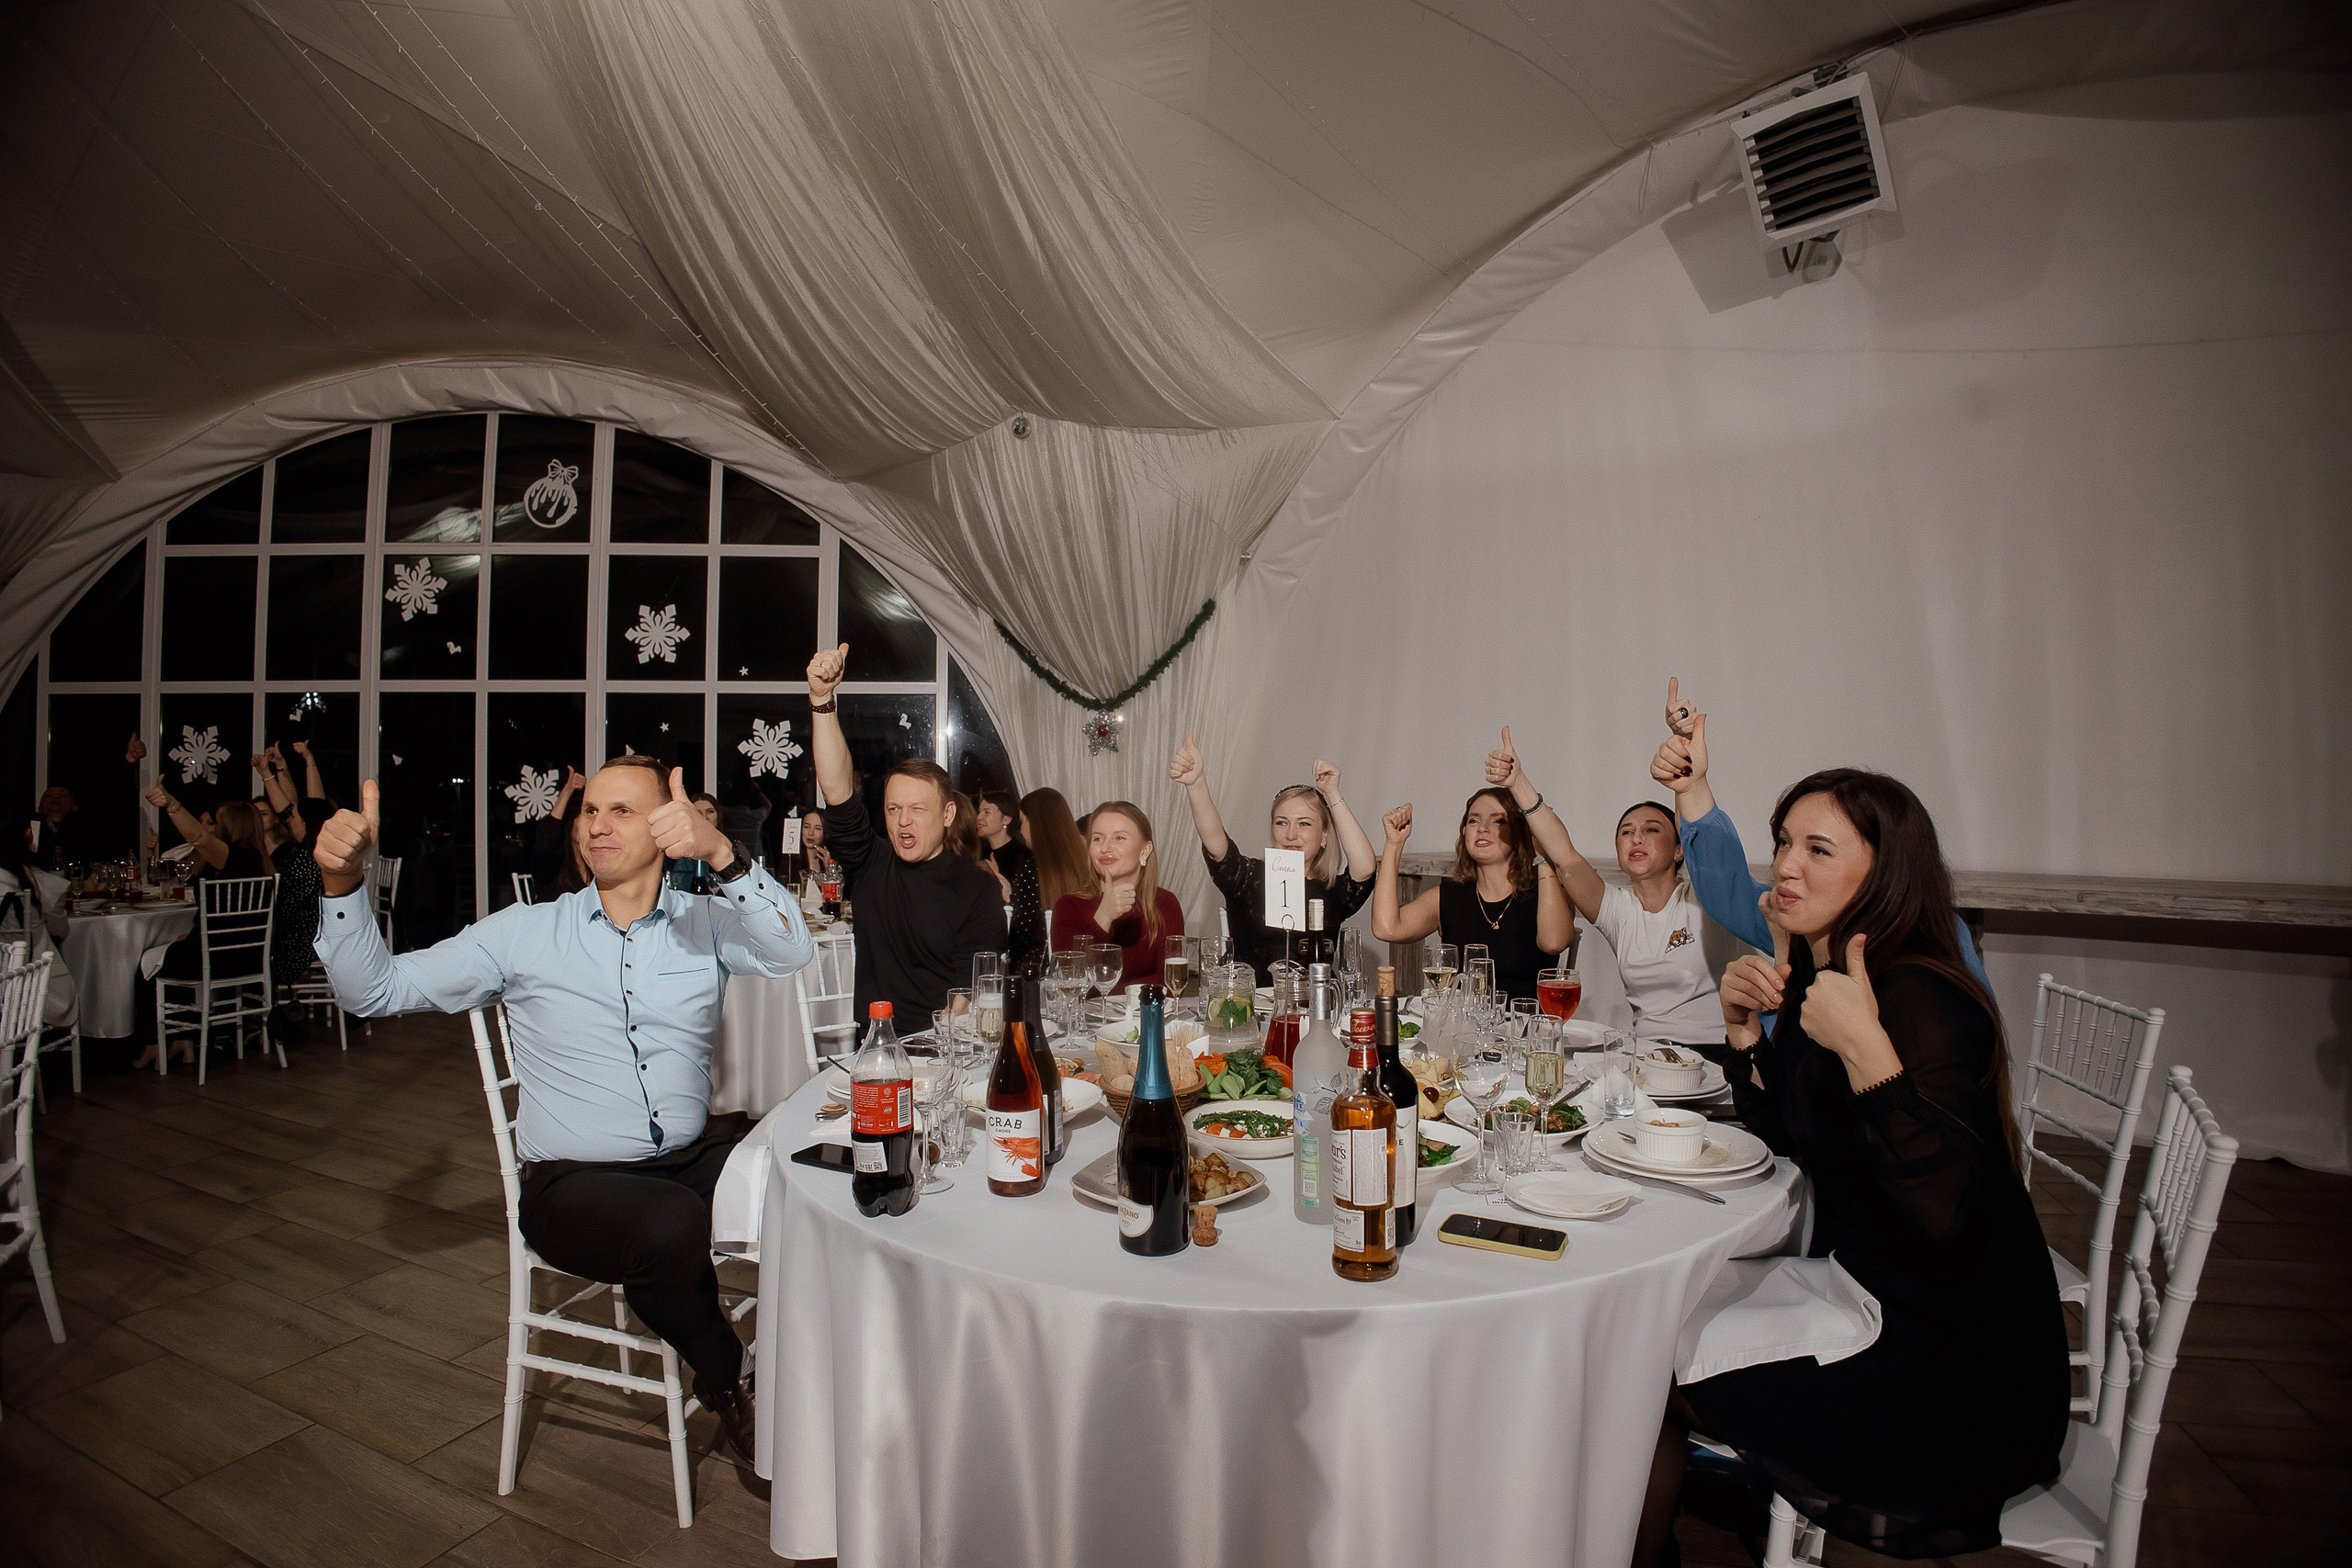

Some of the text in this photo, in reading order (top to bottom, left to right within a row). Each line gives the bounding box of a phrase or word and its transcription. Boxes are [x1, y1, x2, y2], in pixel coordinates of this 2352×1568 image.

[789, 831, 795, 844] 5
[1280, 879, 1290, 908] 1
[989, 1116, 1023, 1130] CRAB
